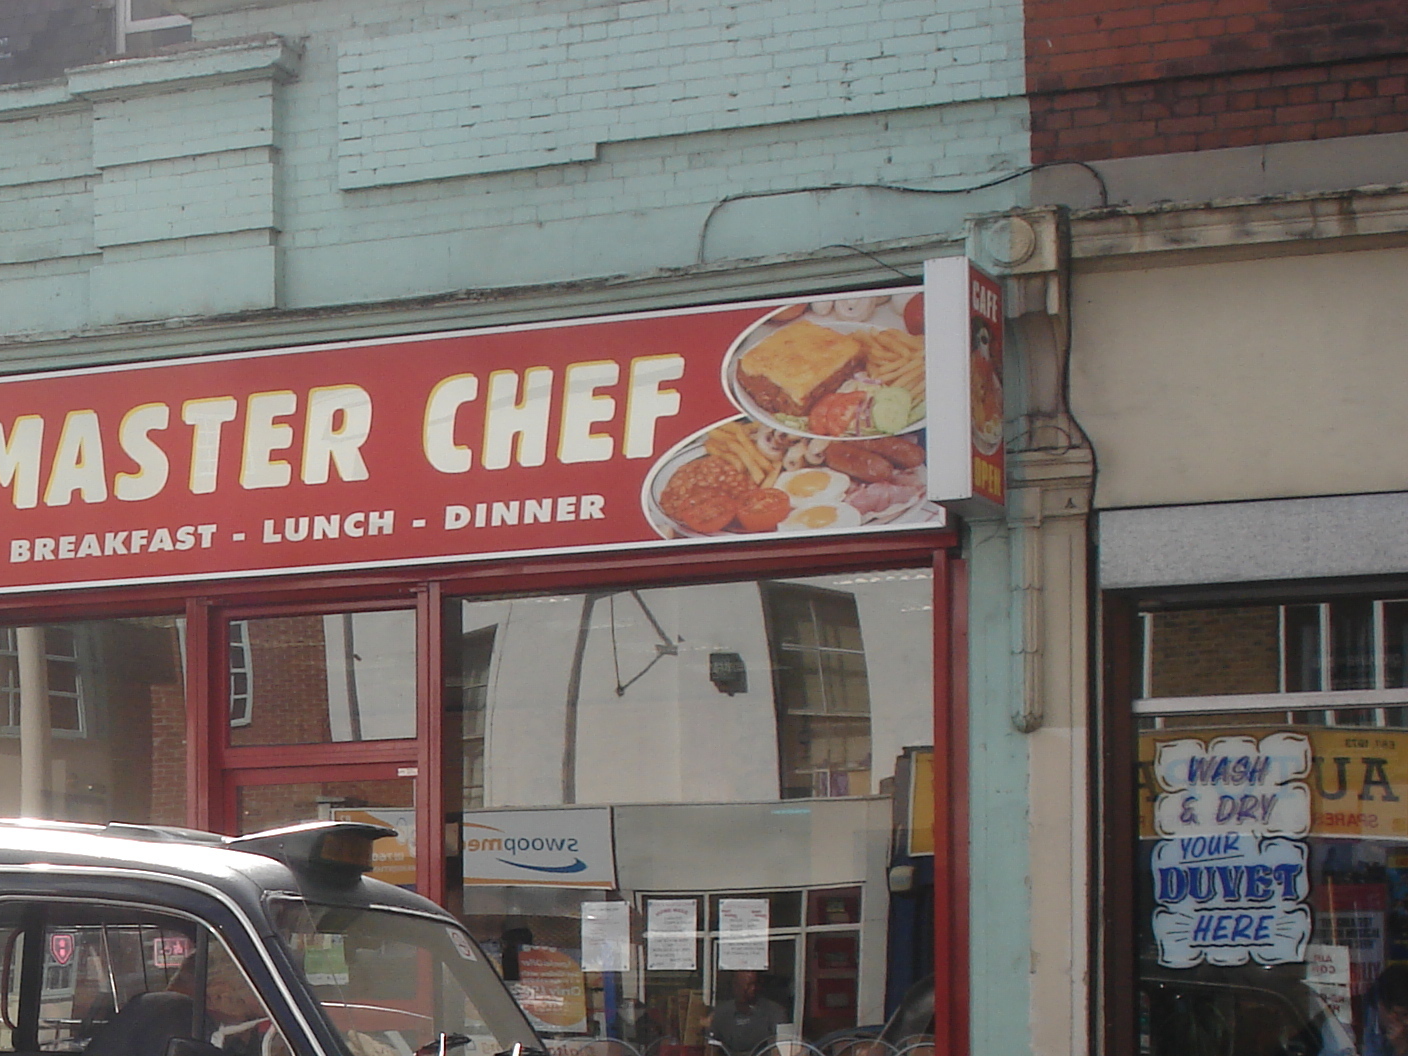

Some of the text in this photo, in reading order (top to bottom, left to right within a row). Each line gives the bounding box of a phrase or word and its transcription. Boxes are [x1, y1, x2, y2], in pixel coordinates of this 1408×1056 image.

[422, 351, 687, 476] CHEF
[973, 456, 1002, 497] OPEN
[9, 519, 218, 564] BREAKFAST
[262, 509, 396, 546] LUNCH
[444, 493, 608, 531] DINNER
[1188, 755, 1270, 787] WASH
[1179, 793, 1277, 825] & DRY
[1179, 832, 1240, 859] YOUR
[1158, 863, 1302, 901] DUVET
[1192, 914, 1274, 942] HERE
